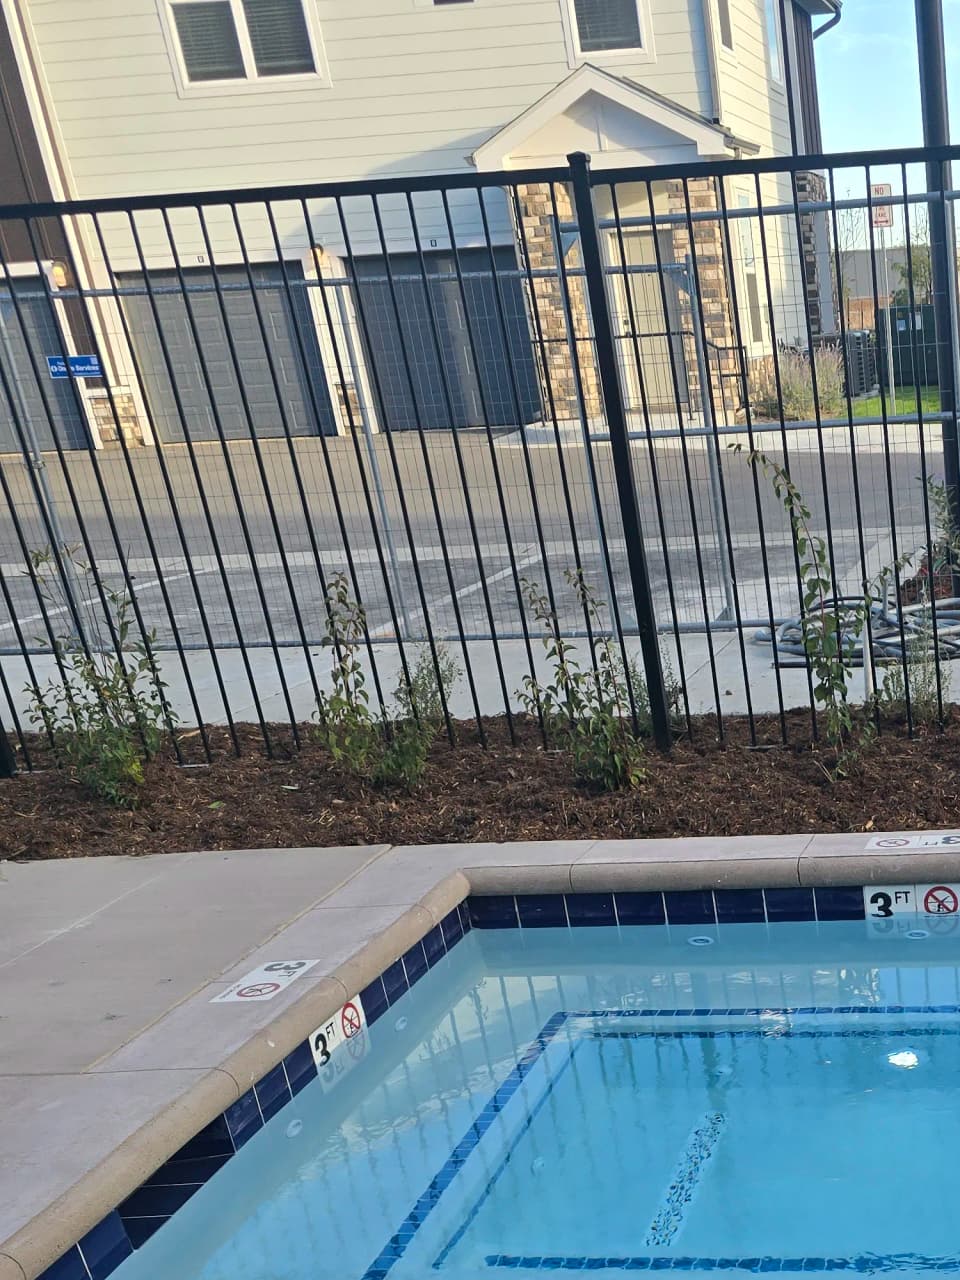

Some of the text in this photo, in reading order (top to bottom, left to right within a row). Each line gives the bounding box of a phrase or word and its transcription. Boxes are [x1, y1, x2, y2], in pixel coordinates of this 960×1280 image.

[870, 891, 911, 918] 3 FT
[264, 961, 307, 972] 3
[315, 1022, 336, 1067] 3 FT
